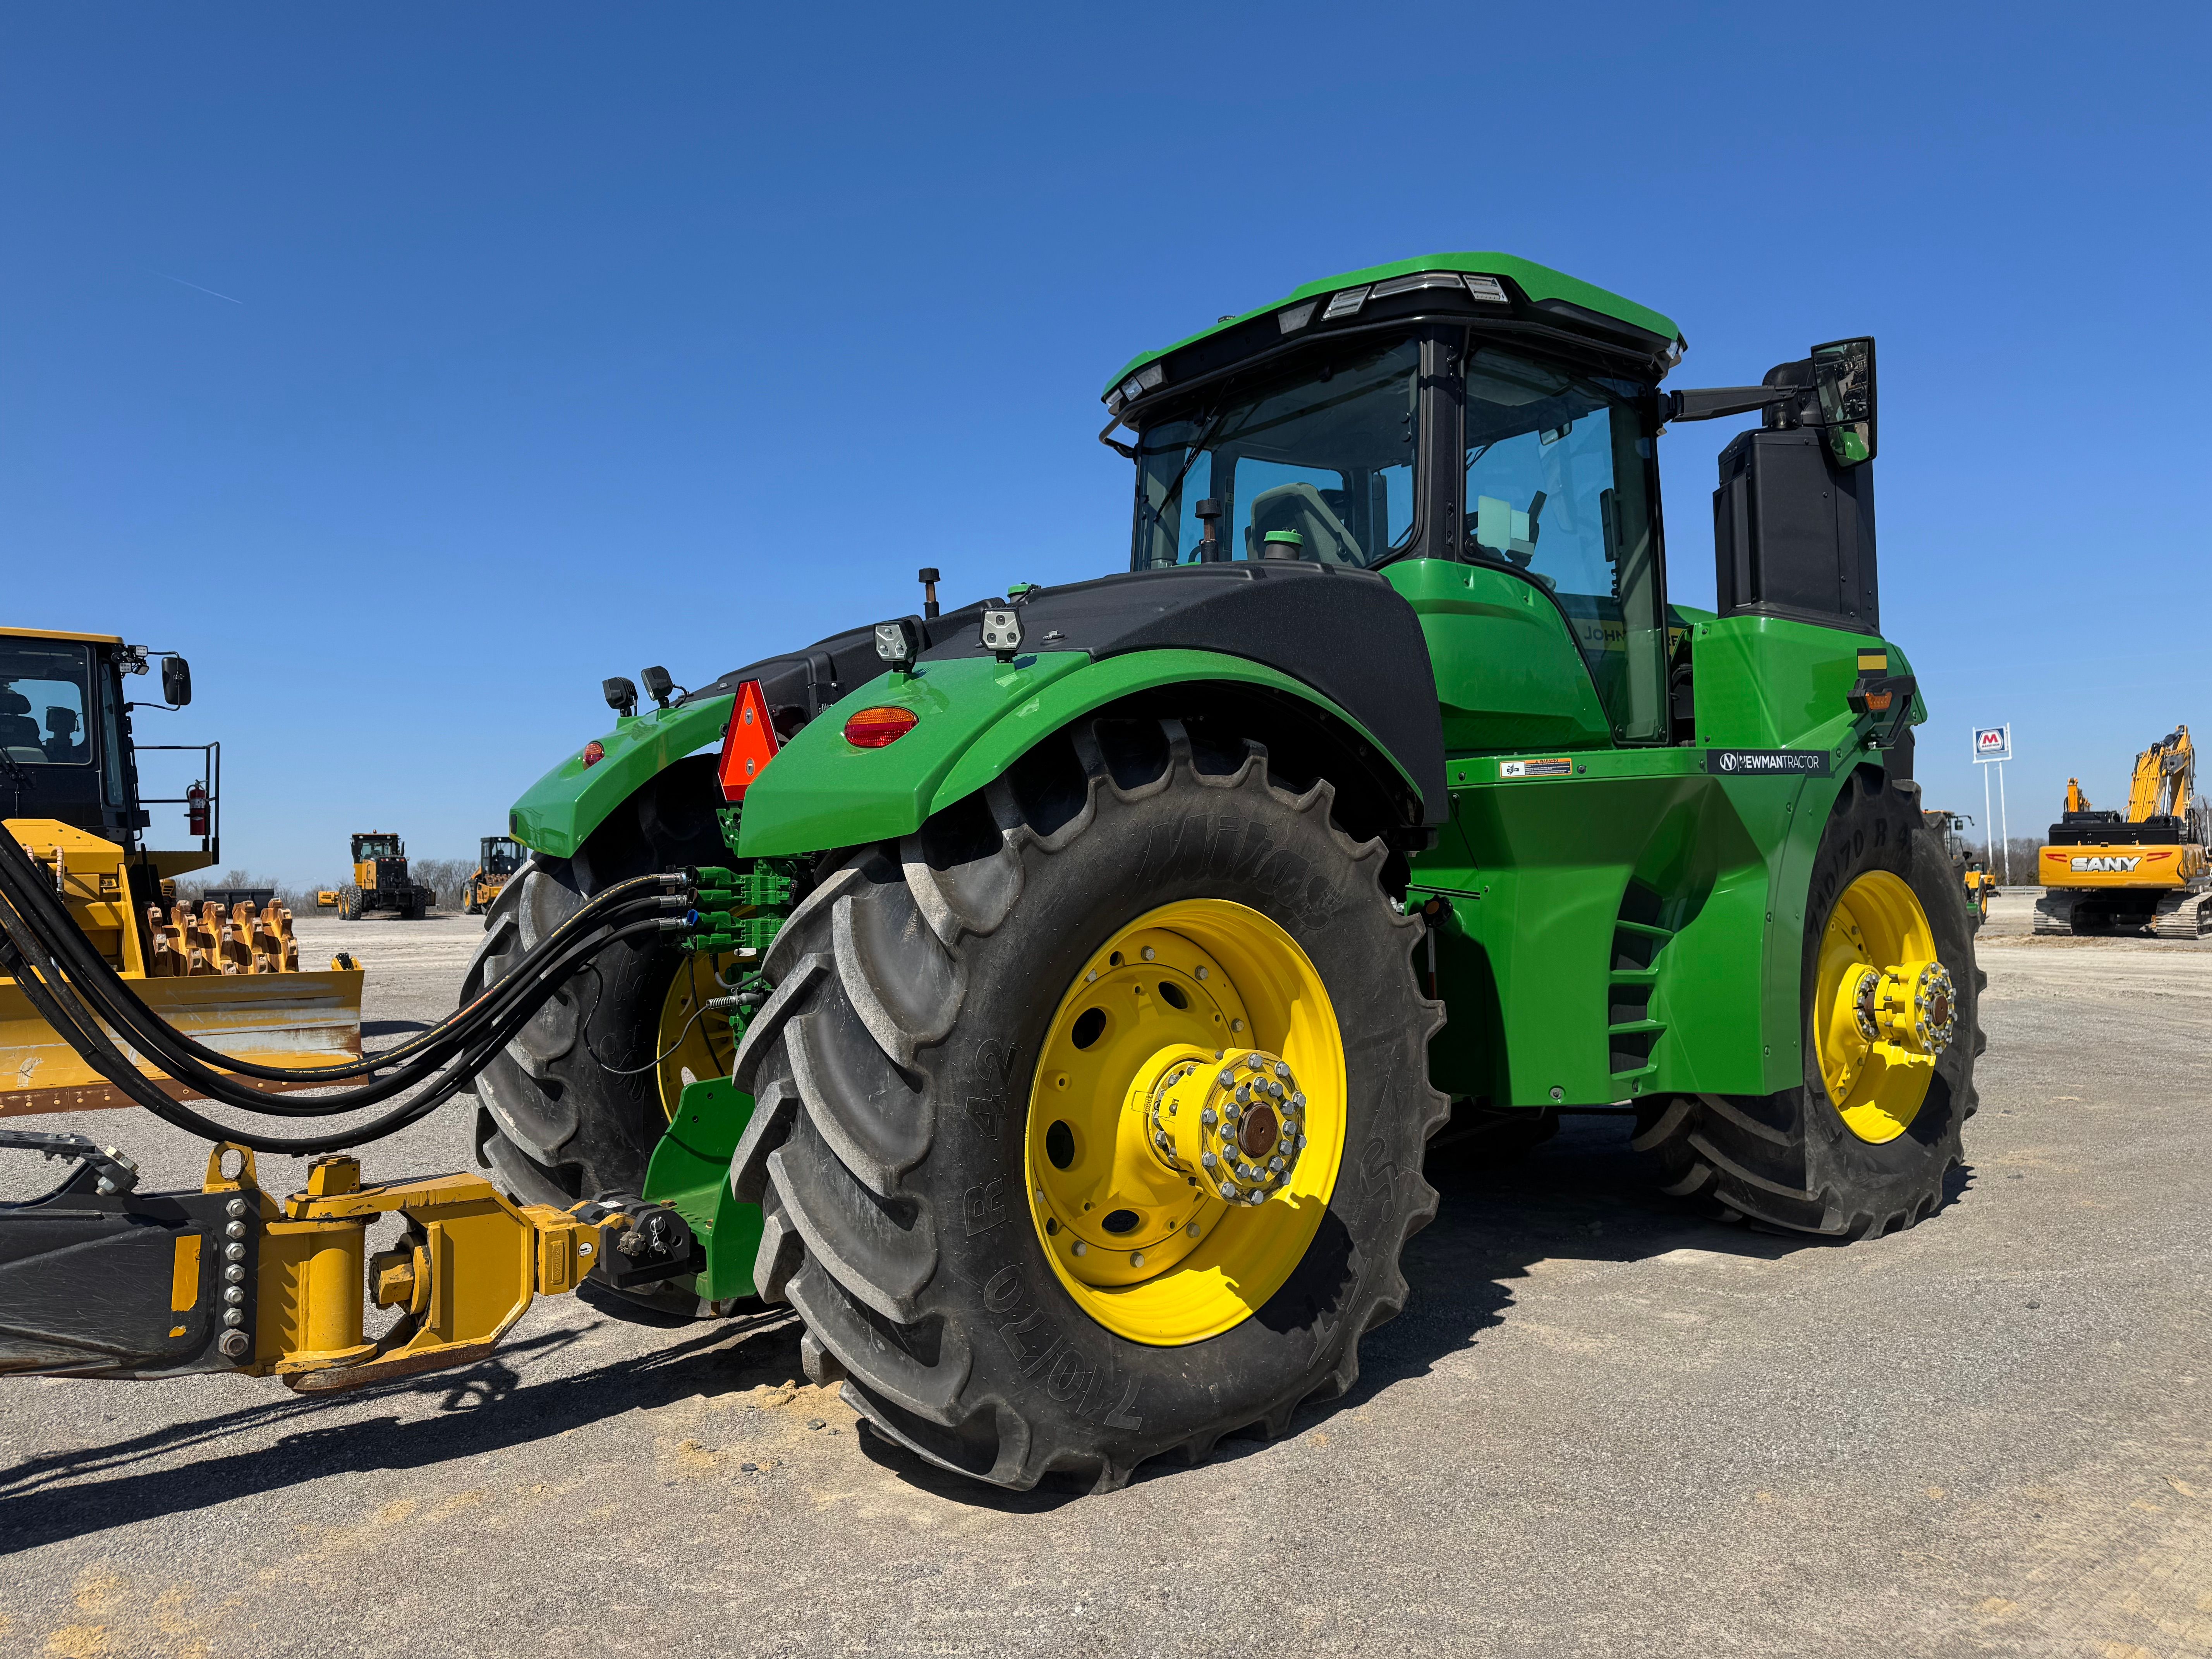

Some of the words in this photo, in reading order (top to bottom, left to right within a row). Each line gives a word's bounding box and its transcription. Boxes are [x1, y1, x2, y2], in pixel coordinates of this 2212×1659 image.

[1983, 734, 1998, 744] M
[2071, 857, 2142, 871] SANY
[965, 1039, 1017, 1138] 42
[963, 1177, 1007, 1237] R
[984, 1265, 1142, 1431] 710/70
